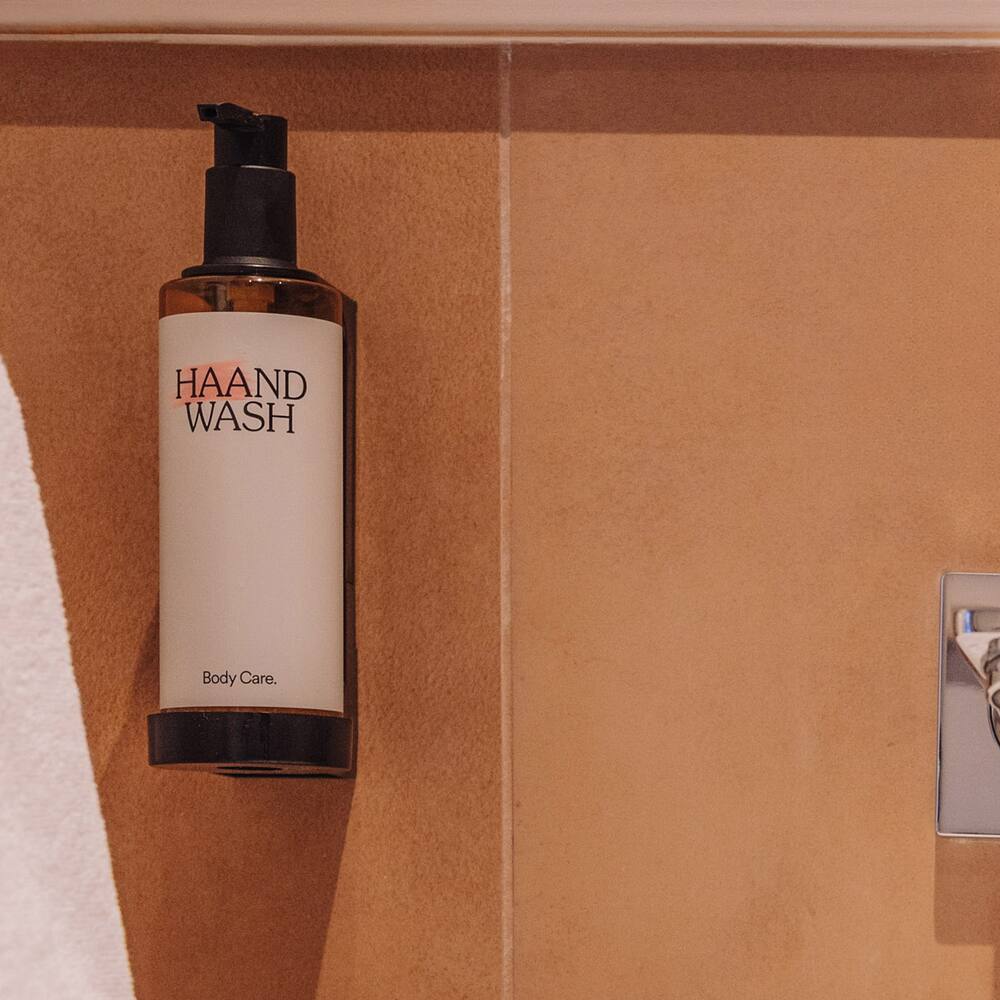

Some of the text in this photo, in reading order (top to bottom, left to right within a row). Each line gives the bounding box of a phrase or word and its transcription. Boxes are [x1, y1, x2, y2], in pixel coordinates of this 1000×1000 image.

[175, 366, 307, 400] HAAND
[184, 400, 295, 434] WASH
[203, 670, 277, 687] Body Care.
